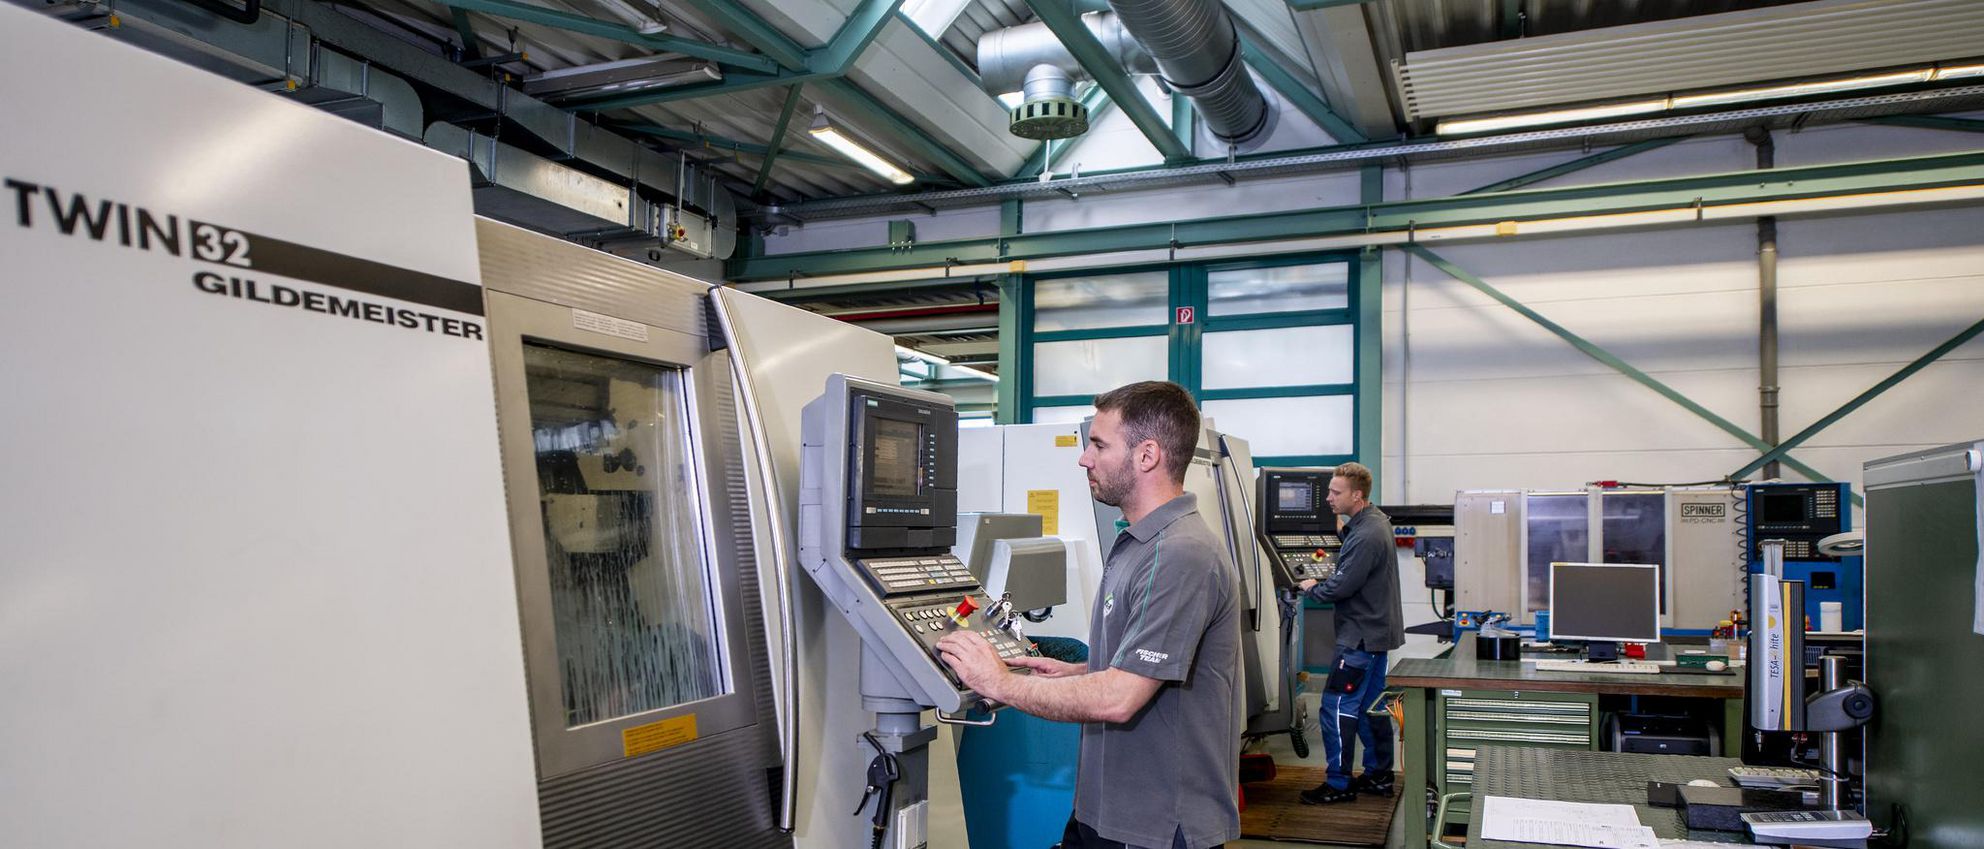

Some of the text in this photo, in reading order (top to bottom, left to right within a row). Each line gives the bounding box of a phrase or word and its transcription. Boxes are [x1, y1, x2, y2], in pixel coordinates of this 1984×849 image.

[4, 178, 252, 267] TWIN 32
[192, 271, 484, 341] GILDEMEISTER
[1684, 505, 1722, 515] SPINNER
[1135, 648, 1169, 660] FISCHER
